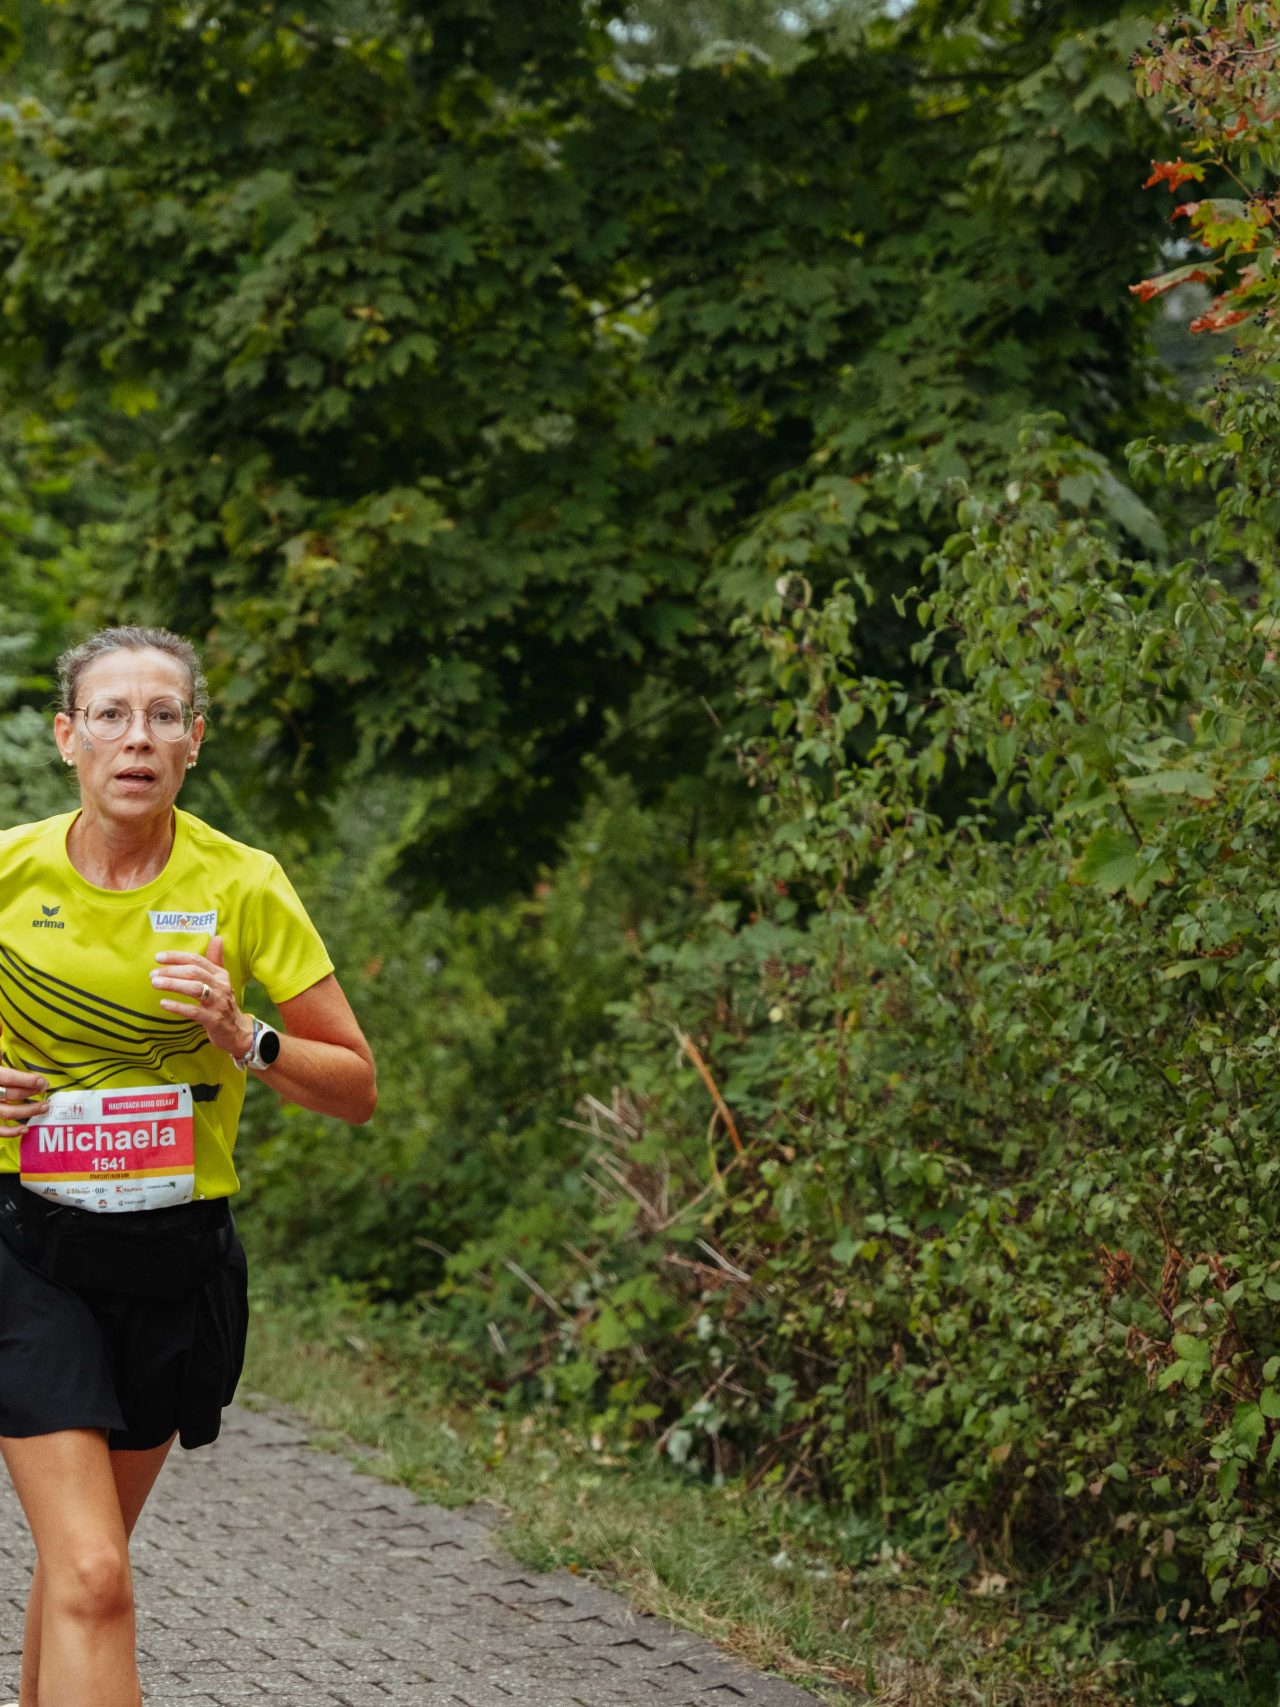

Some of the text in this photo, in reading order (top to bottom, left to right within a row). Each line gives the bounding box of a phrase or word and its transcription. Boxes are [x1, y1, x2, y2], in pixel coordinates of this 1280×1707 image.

[32, 918, 64, 929] erima
[38, 1122, 176, 1153] Michaela
[91, 1157, 126, 1171] 1541
